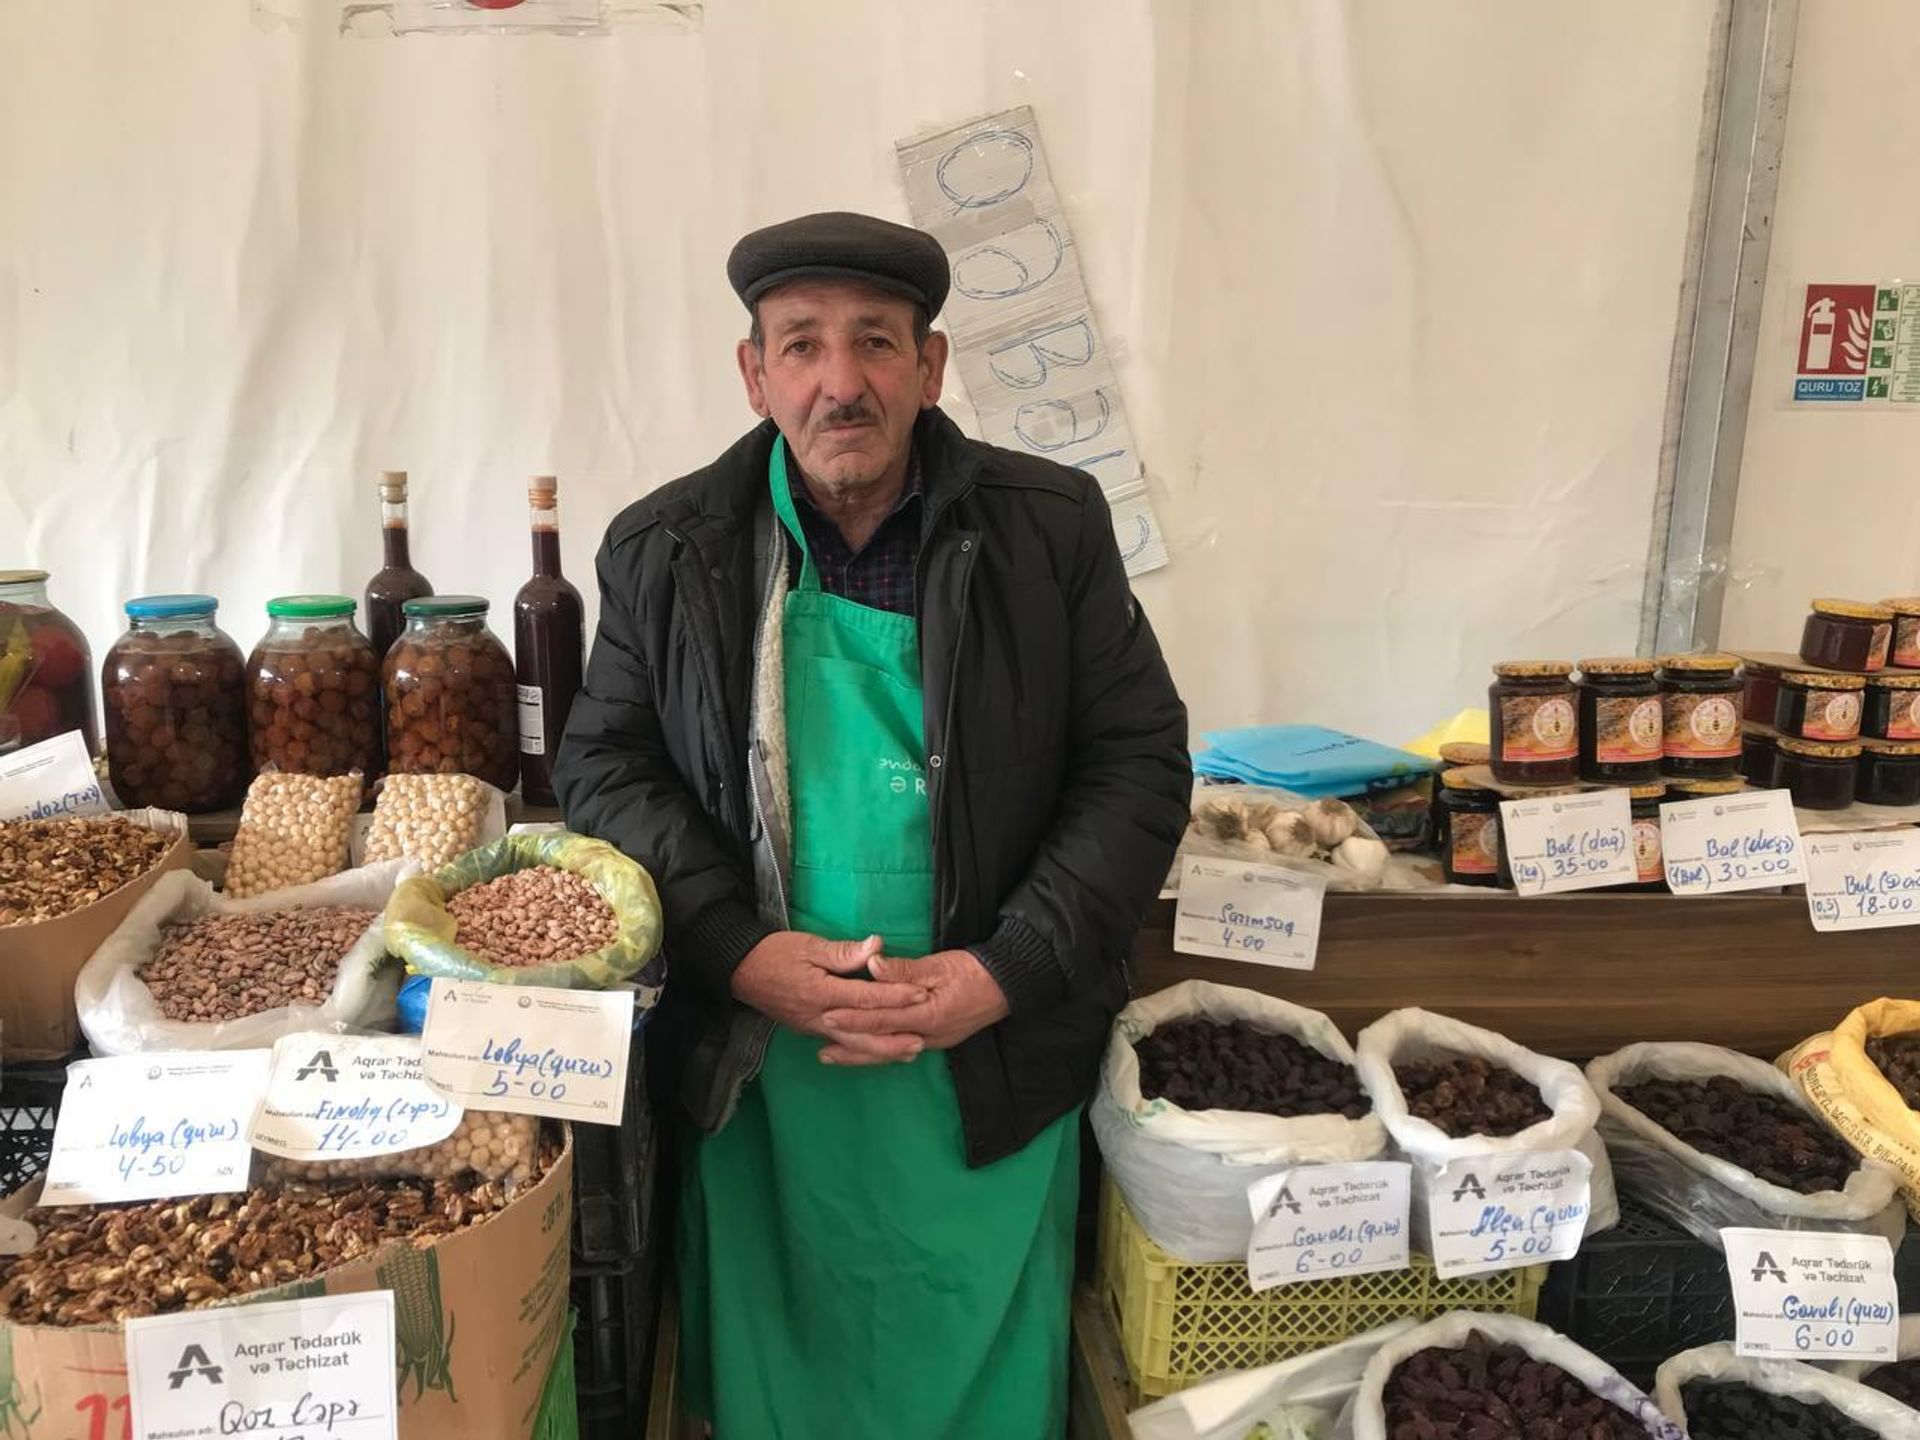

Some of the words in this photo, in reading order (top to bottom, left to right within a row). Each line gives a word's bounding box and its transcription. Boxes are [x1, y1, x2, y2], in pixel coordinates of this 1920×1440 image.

[1798, 381, 1834, 393] QURU
[1837, 381, 1862, 393] TOZ
[1552, 857, 1609, 878] 35-00
[1718, 858, 1790, 882] 30-00
[1856, 895, 1913, 917] 18-00
[1223, 927, 1265, 950] 4-00
[352, 1055, 391, 1069] Aqrar
[360, 1072, 375, 1081] və
[380, 1069, 424, 1081] Təchiz
[482, 1069, 567, 1100] 5-00
[118, 1154, 186, 1182] 4-50
[1494, 1172, 1527, 1185] Aqrar
[1309, 1184, 1341, 1197] Aqrar
[1482, 1235, 1553, 1263] 5-00
[1296, 1247, 1364, 1274] 6-00
[1791, 1257, 1824, 1270] Aqrar
[1828, 1257, 1873, 1271] Tədarük
[1818, 1270, 1866, 1284] Təchizat
[234, 1341, 286, 1359] Aqrar
[290, 1331, 363, 1352] Tədarük
[1795, 1323, 1855, 1352] 6-00
[250, 1363, 271, 1376] və
[275, 1351, 350, 1373] Təchizat
